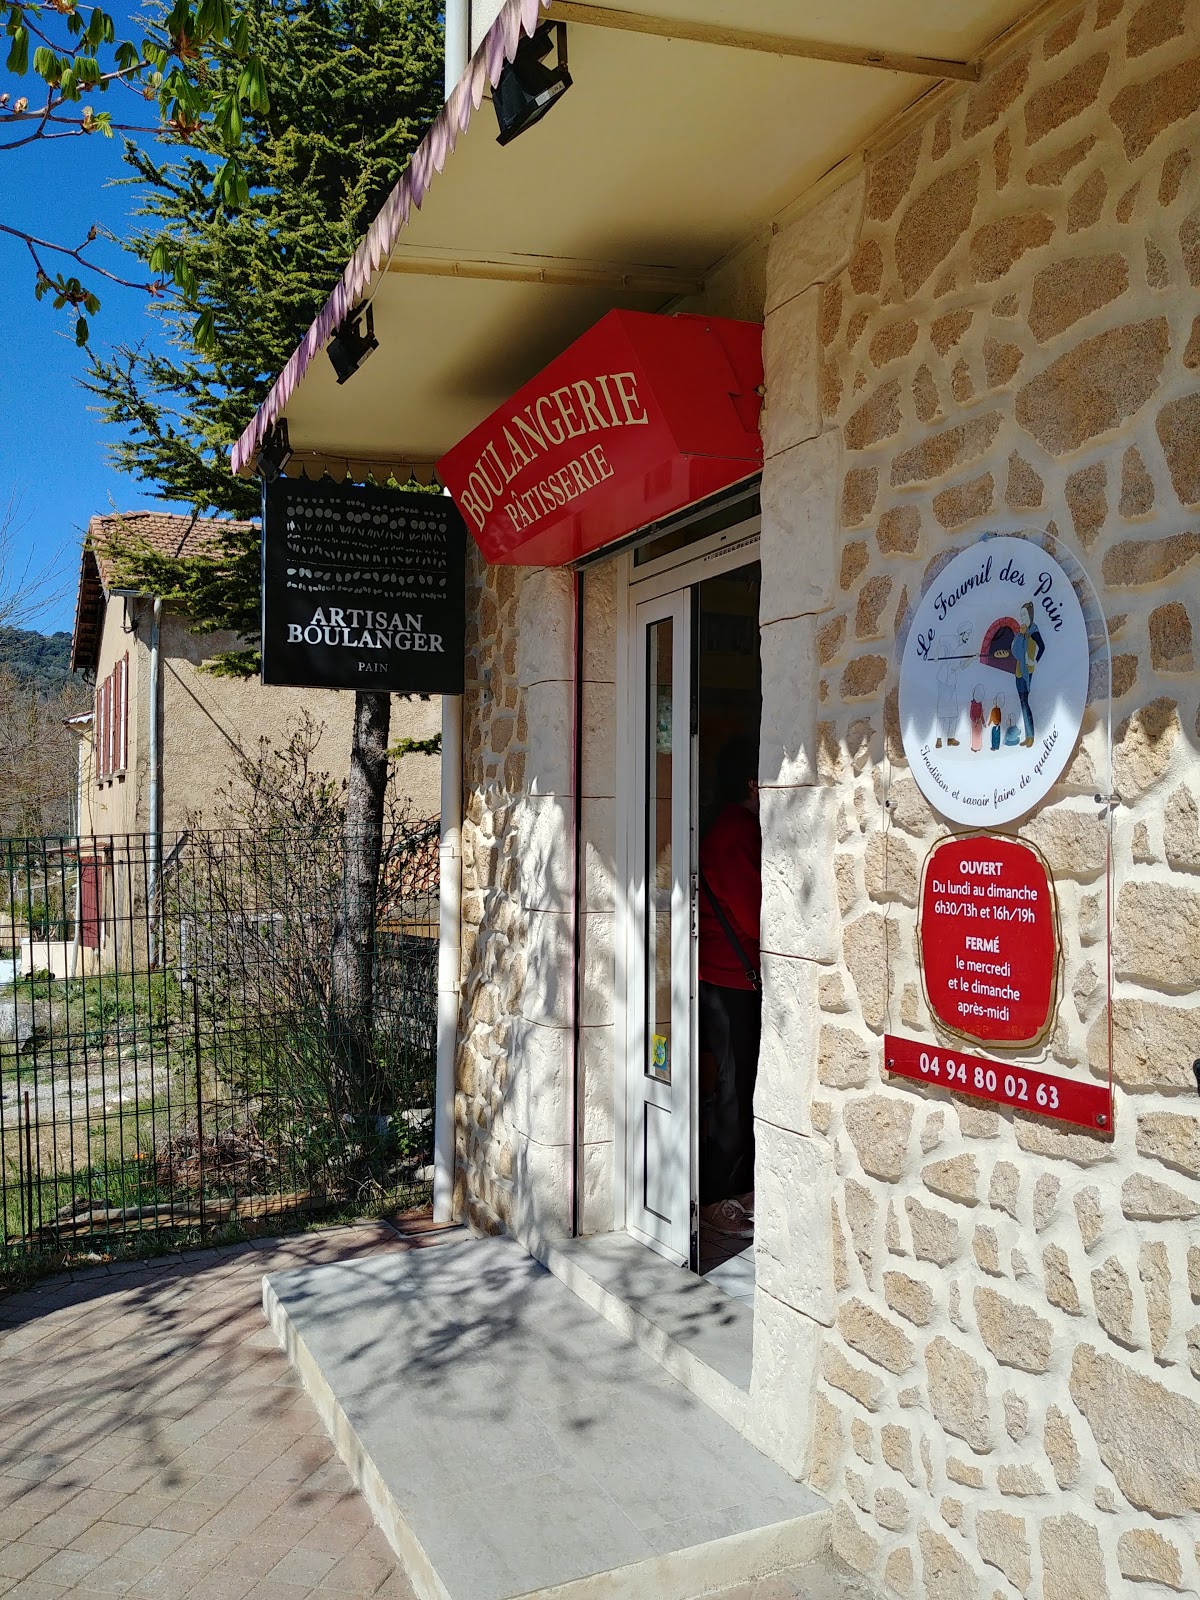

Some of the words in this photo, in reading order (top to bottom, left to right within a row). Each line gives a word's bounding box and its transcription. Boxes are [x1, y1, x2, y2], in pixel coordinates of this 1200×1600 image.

[460, 372, 649, 532] BOULANGERIE
[504, 444, 615, 532] PÂTISSERIE
[310, 606, 423, 632] ARTISAN
[917, 628, 936, 661] Le
[934, 555, 993, 620] Fournil
[1000, 558, 1026, 586] des
[1034, 571, 1065, 632] Pain
[287, 623, 445, 653] BOULANGER
[358, 662, 388, 672] PAIN
[920, 745, 949, 793] Tradition
[951, 790, 960, 800] et
[962, 794, 990, 808] savoir
[993, 788, 1016, 810] faire
[1019, 774, 1031, 790] de
[1033, 724, 1060, 775] qualité
[959, 860, 1003, 876] OUVERT
[932, 880, 947, 894] Du
[947, 881, 971, 896] lundi
[973, 886, 985, 897] au
[987, 884, 1038, 901] dimanche
[934, 902, 978, 919] 6h30/13h
[980, 908, 991, 919] et
[992, 906, 1036, 924] 16h/19h
[965, 936, 1000, 953] FERMÉ
[955, 955, 965, 969] le
[966, 959, 1011, 977] mercredi
[948, 977, 959, 989] et
[960, 979, 970, 992] le
[971, 981, 1020, 1001] dimanche
[957, 1000, 1010, 1021] après-midi
[919, 1052, 940, 1076] 04
[946, 1062, 967, 1084] 94
[974, 1069, 997, 1092] 80
[1004, 1077, 1028, 1101] 02
[1036, 1084, 1059, 1109] 63
